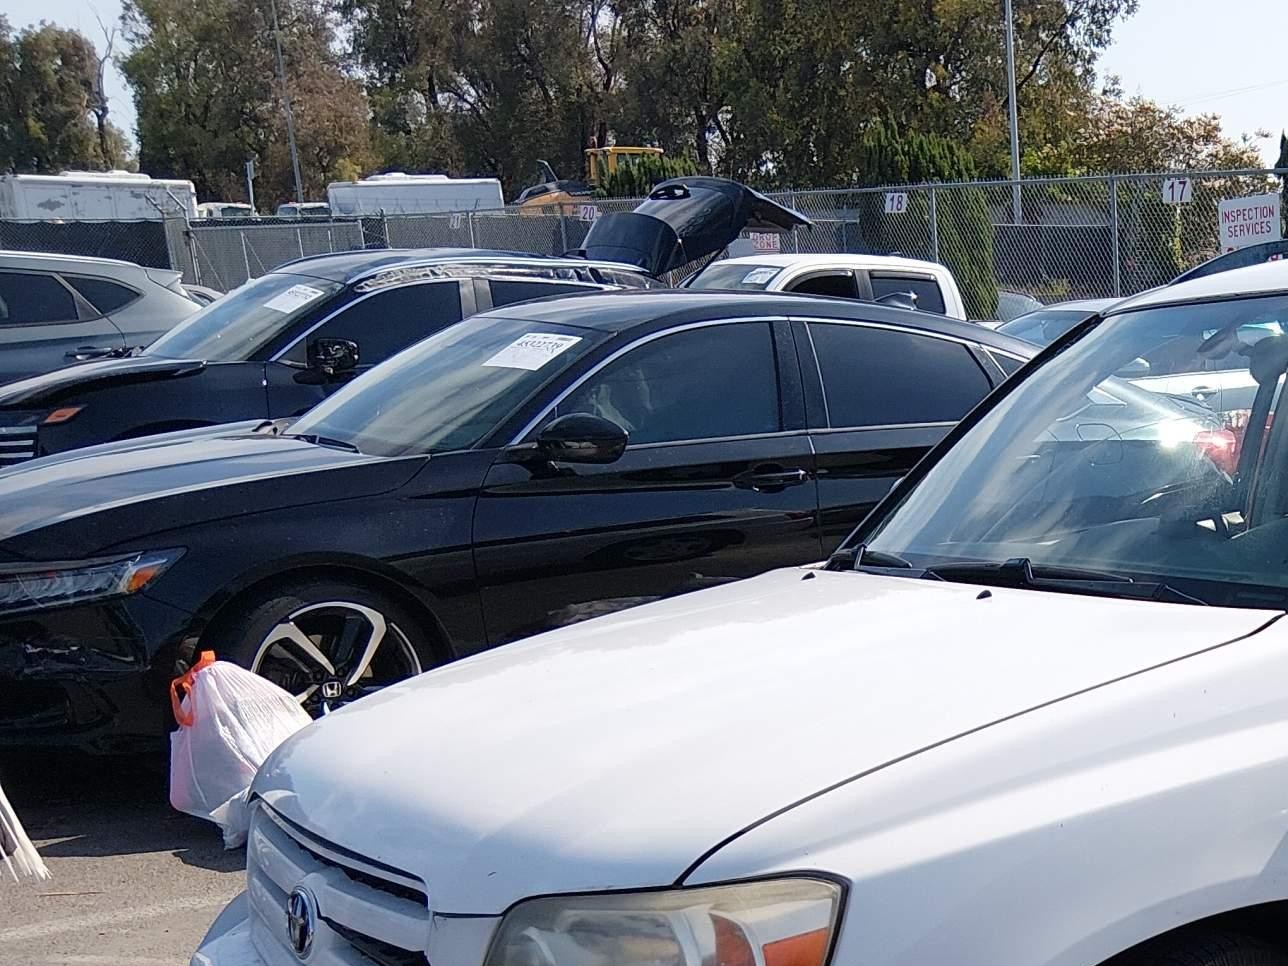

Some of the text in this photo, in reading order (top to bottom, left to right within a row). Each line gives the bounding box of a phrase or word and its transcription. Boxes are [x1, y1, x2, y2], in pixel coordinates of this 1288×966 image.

[1168, 181, 1187, 201] 17
[890, 194, 904, 211] 18
[583, 206, 595, 220] 20
[1221, 205, 1275, 224] INSPECTION
[1227, 221, 1272, 238] SERVICES
[753, 241, 778, 249] ZONE
